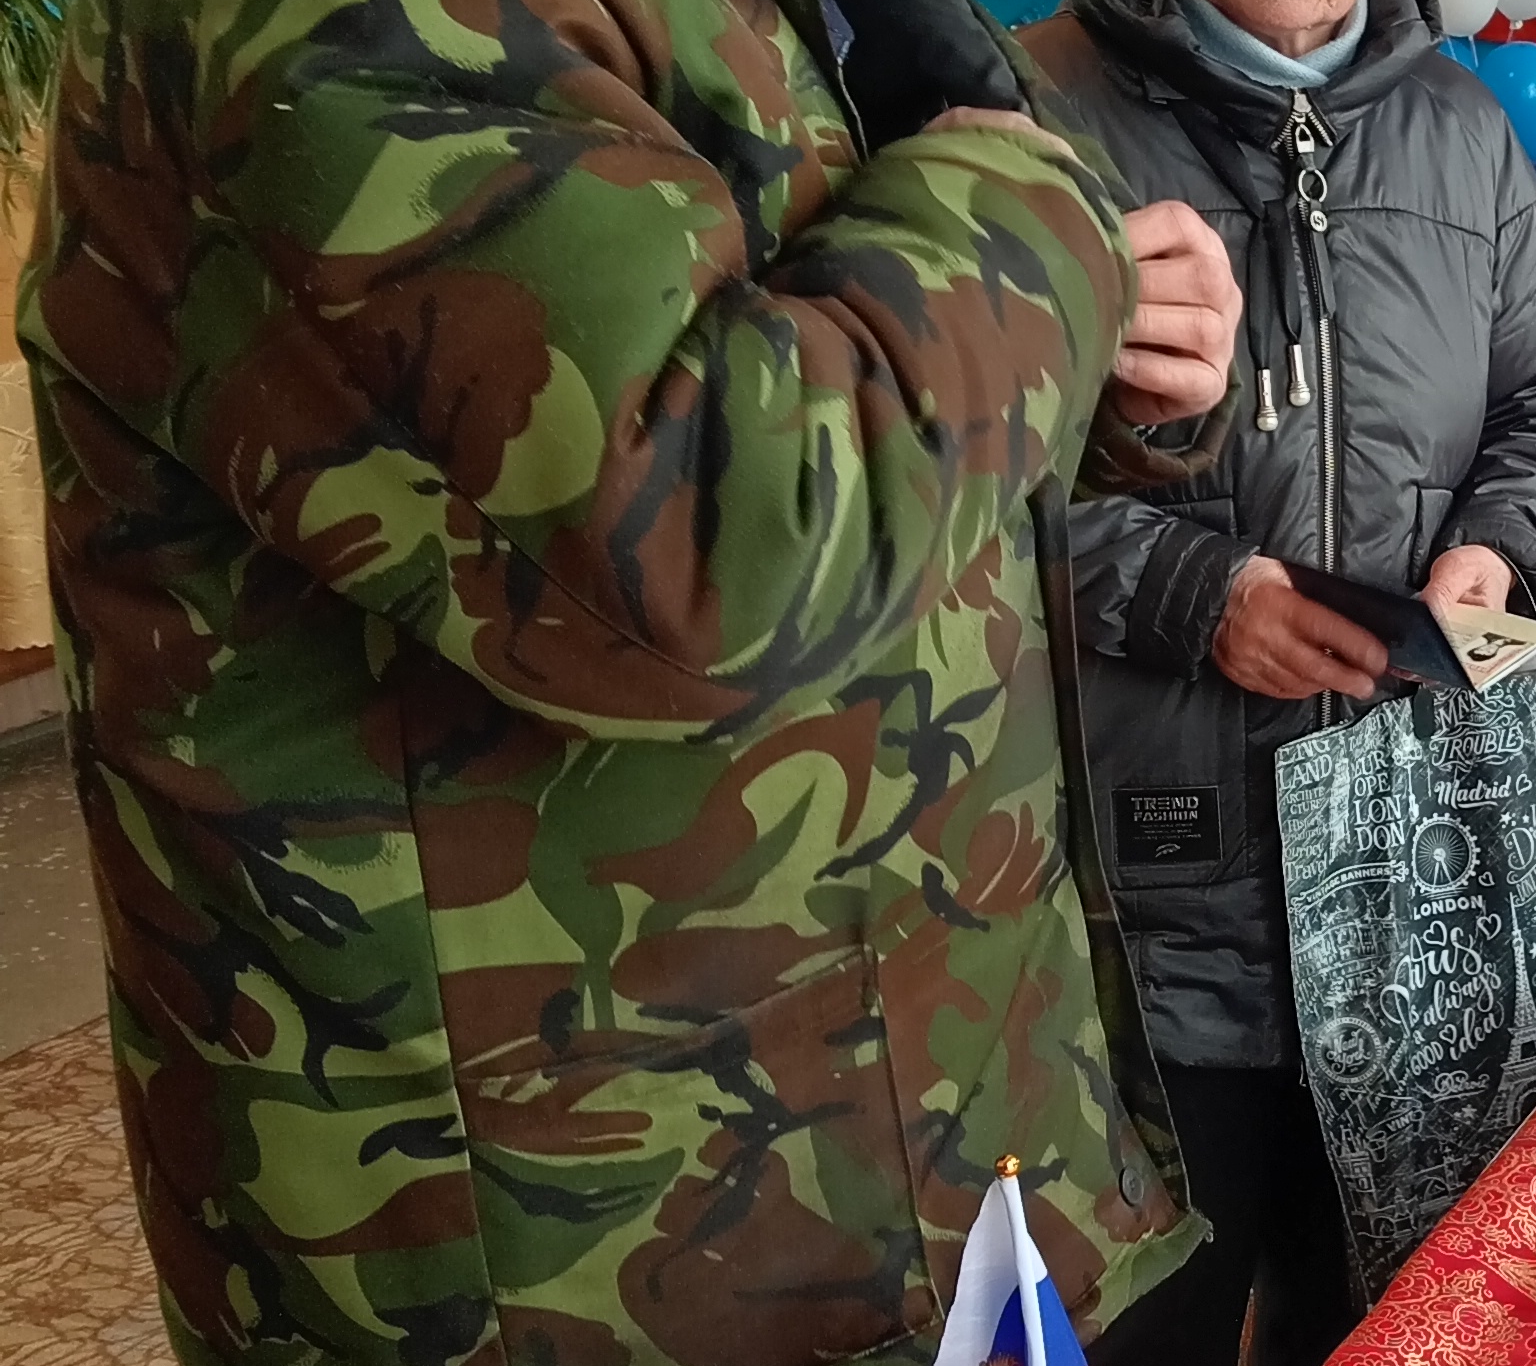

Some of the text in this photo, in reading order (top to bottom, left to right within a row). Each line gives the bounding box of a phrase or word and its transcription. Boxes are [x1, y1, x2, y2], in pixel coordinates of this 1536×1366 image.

[1278, 737, 1330, 763] ENG
[1430, 722, 1524, 766] TROUBLE
[1278, 754, 1333, 790] LAND
[1354, 750, 1389, 778] EUR
[1354, 773, 1391, 797] OPE
[1434, 775, 1512, 810] Madrid
[1131, 796, 1199, 810] TREND
[1133, 810, 1198, 822] FASHION
[1354, 794, 1402, 826] LON
[1354, 820, 1406, 853] DON
[1306, 867, 1394, 902] VINTAGE BANNERS
[1413, 895, 1484, 921] LONDON
[1423, 962, 1501, 1026] always
[1410, 1001, 1505, 1076] GOOD idea
